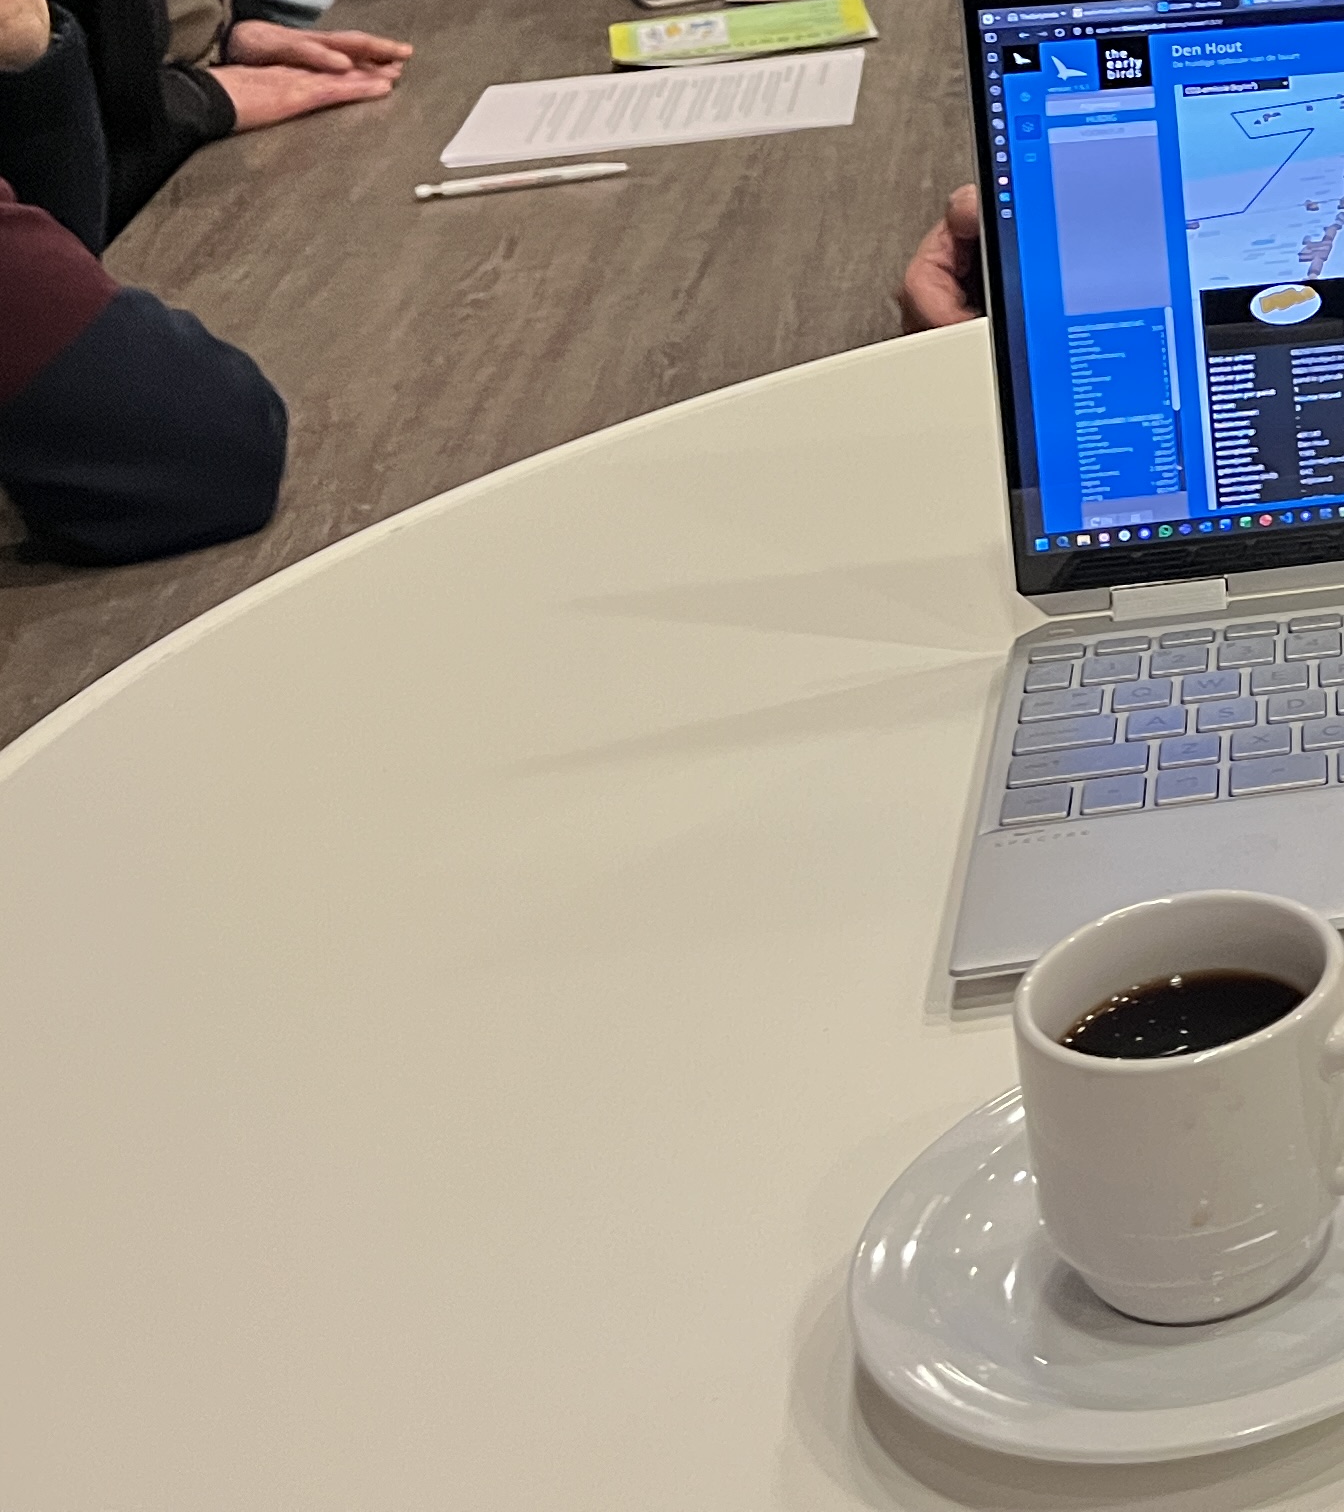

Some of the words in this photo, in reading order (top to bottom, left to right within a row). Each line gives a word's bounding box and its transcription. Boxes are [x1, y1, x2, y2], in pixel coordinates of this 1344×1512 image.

[1105, 49, 1128, 59] the
[1171, 45, 1202, 57] Den
[1205, 42, 1242, 54] Hout
[1106, 57, 1142, 69] early
[1106, 68, 1142, 79] birds
[1197, 678, 1225, 689] W
[1145, 715, 1166, 726] A
[1218, 707, 1234, 718] S
[1287, 699, 1305, 709] D
[1181, 743, 1199, 754] Z
[1252, 734, 1270, 744] X
[1322, 725, 1342, 736] C
